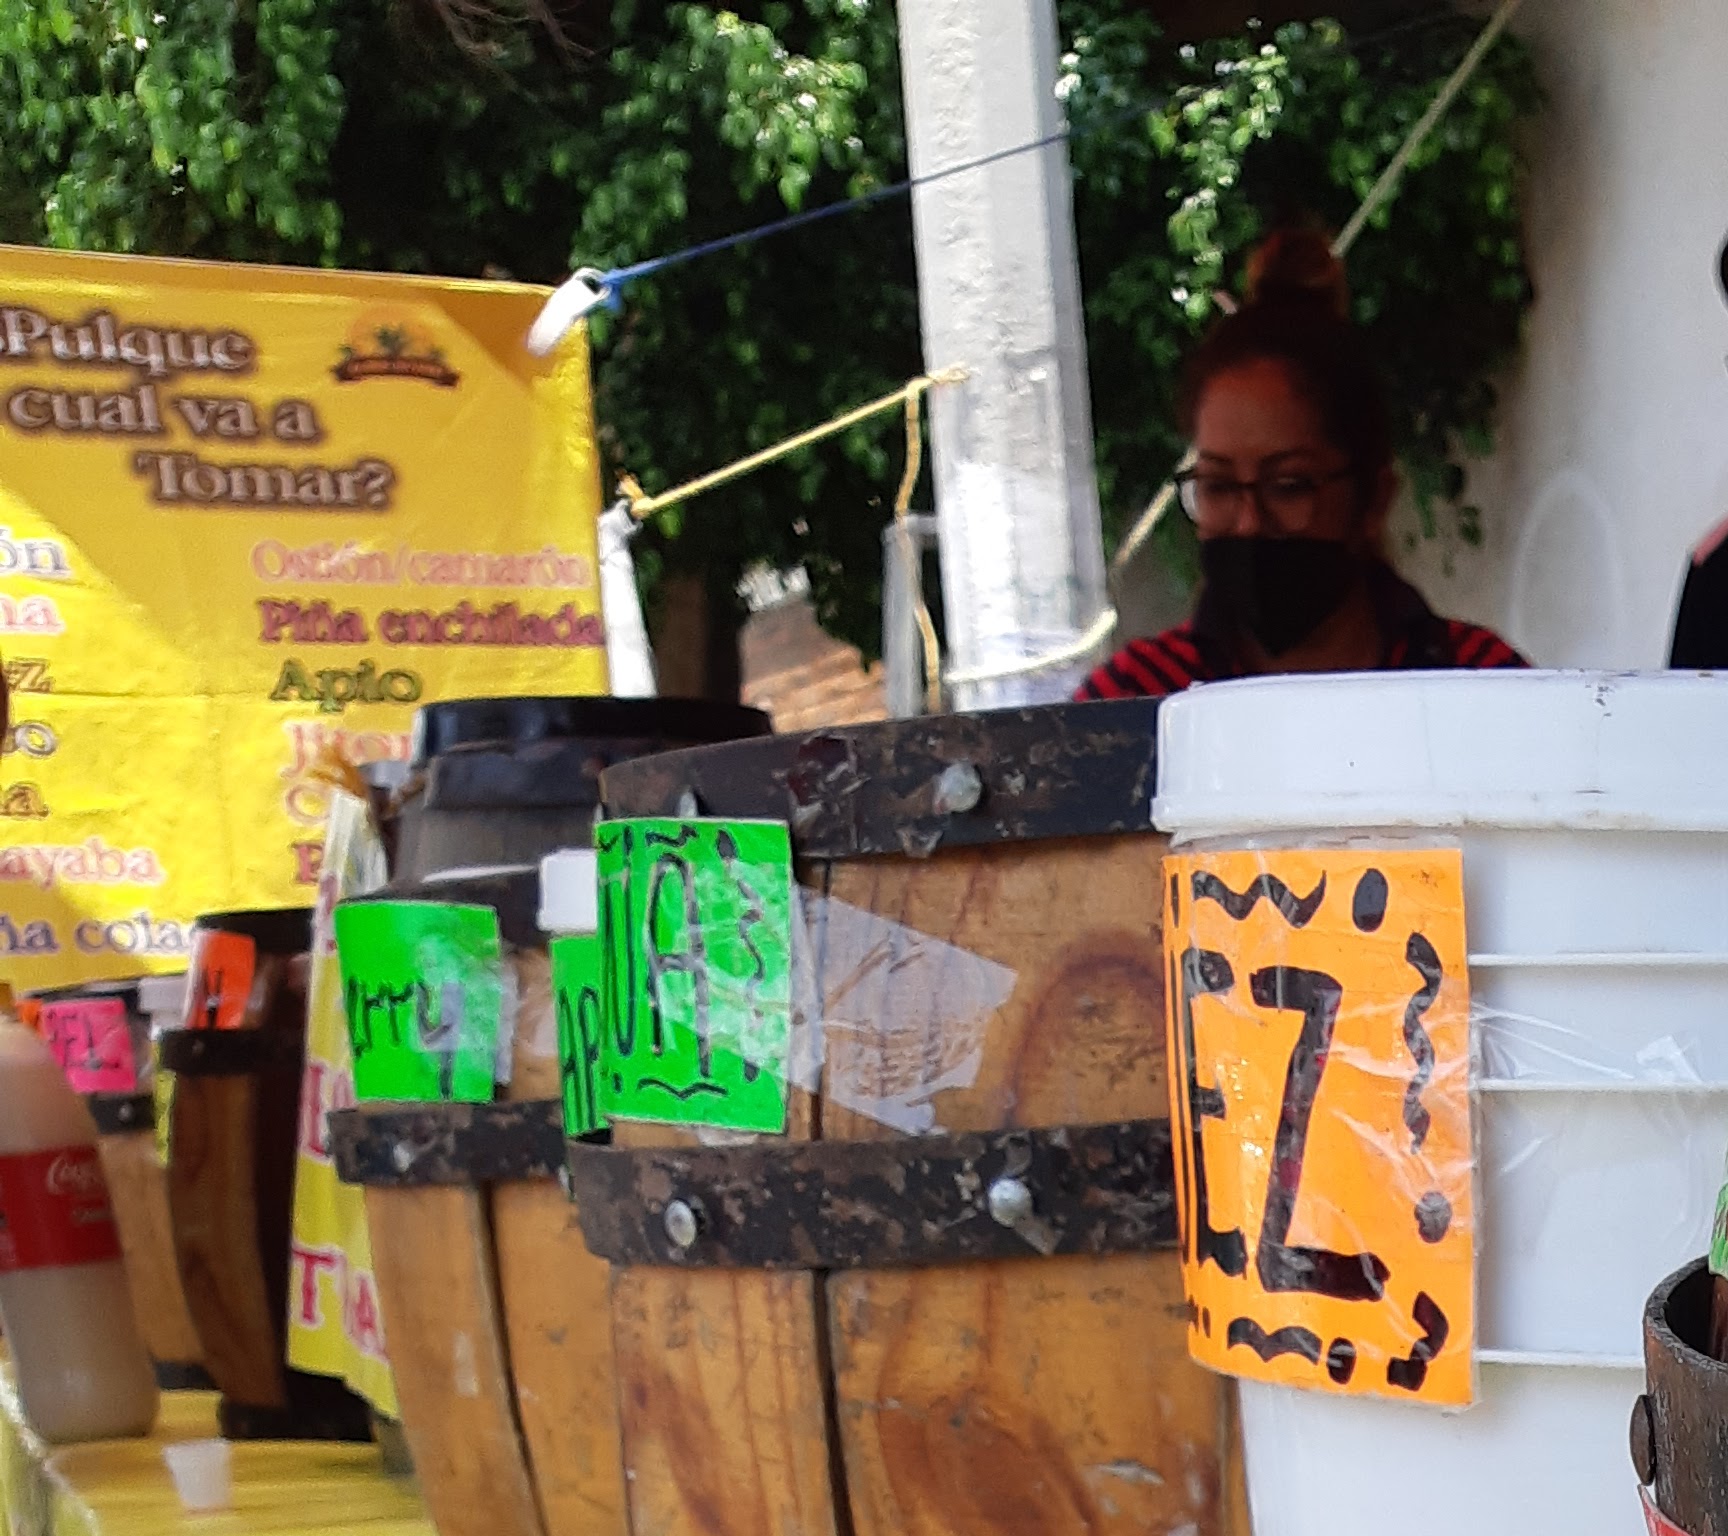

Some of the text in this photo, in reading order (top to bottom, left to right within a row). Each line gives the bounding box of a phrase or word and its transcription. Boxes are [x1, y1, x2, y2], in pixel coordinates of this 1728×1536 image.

[2, 305, 256, 378] Pulque
[7, 383, 320, 442] cual va a
[136, 452, 394, 508] Tomar?
[257, 599, 369, 643] Piña
[269, 659, 423, 712] Apio
